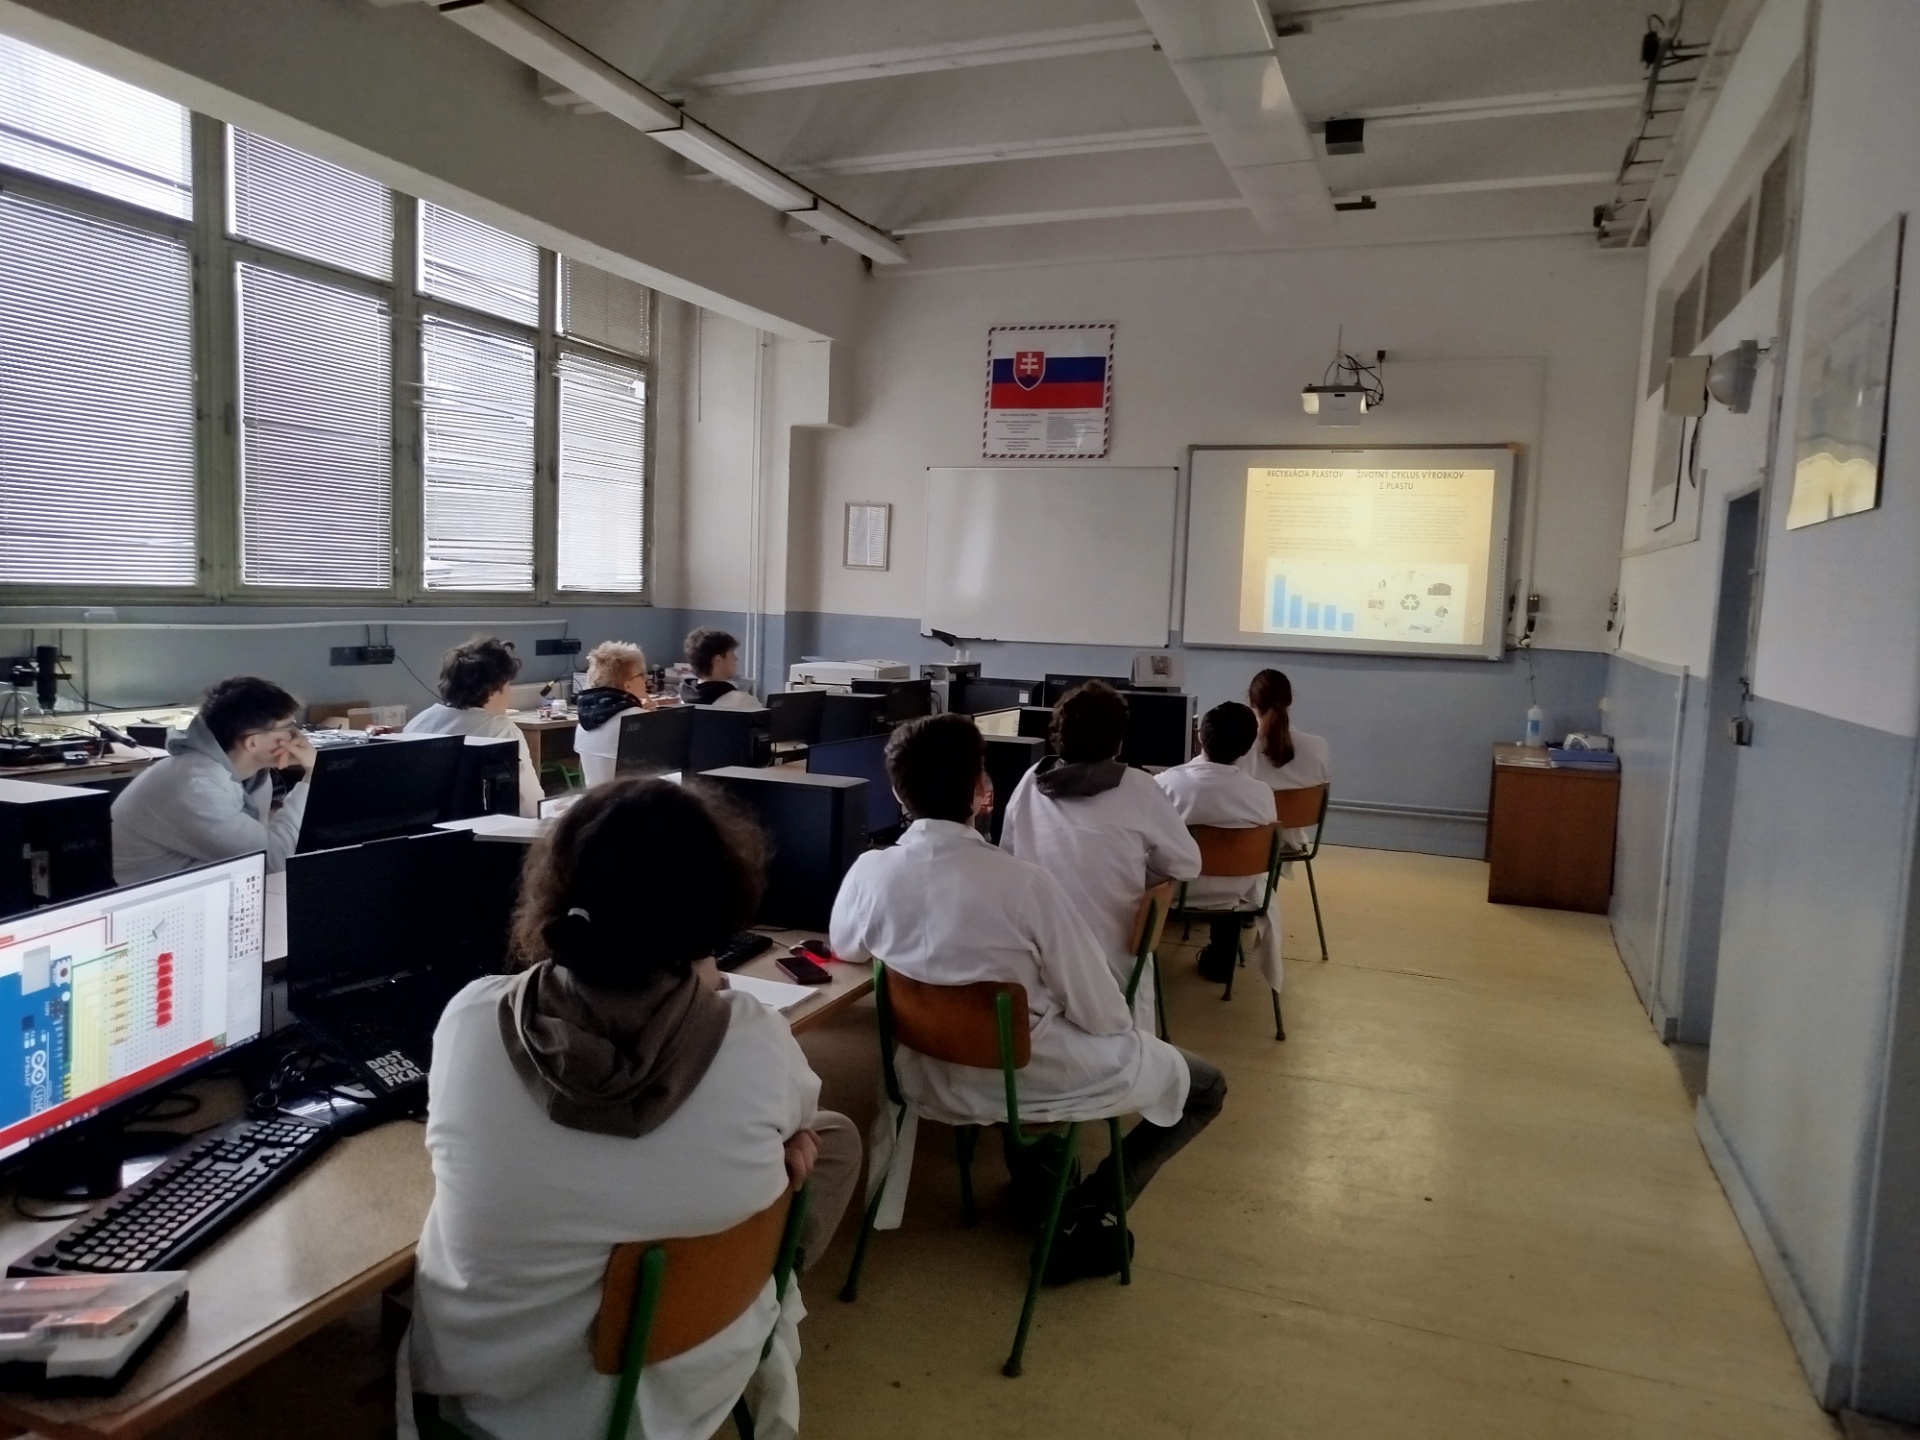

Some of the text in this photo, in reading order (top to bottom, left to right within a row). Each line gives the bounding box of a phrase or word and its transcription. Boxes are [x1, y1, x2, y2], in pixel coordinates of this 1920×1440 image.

[1311, 470, 1344, 478] PLASTOV
[1391, 471, 1420, 479] CYKLUS
[1422, 469, 1464, 479] VÝROBKOV
[1379, 482, 1414, 490] Z PLASTU
[375, 1060, 415, 1078] BOLO
